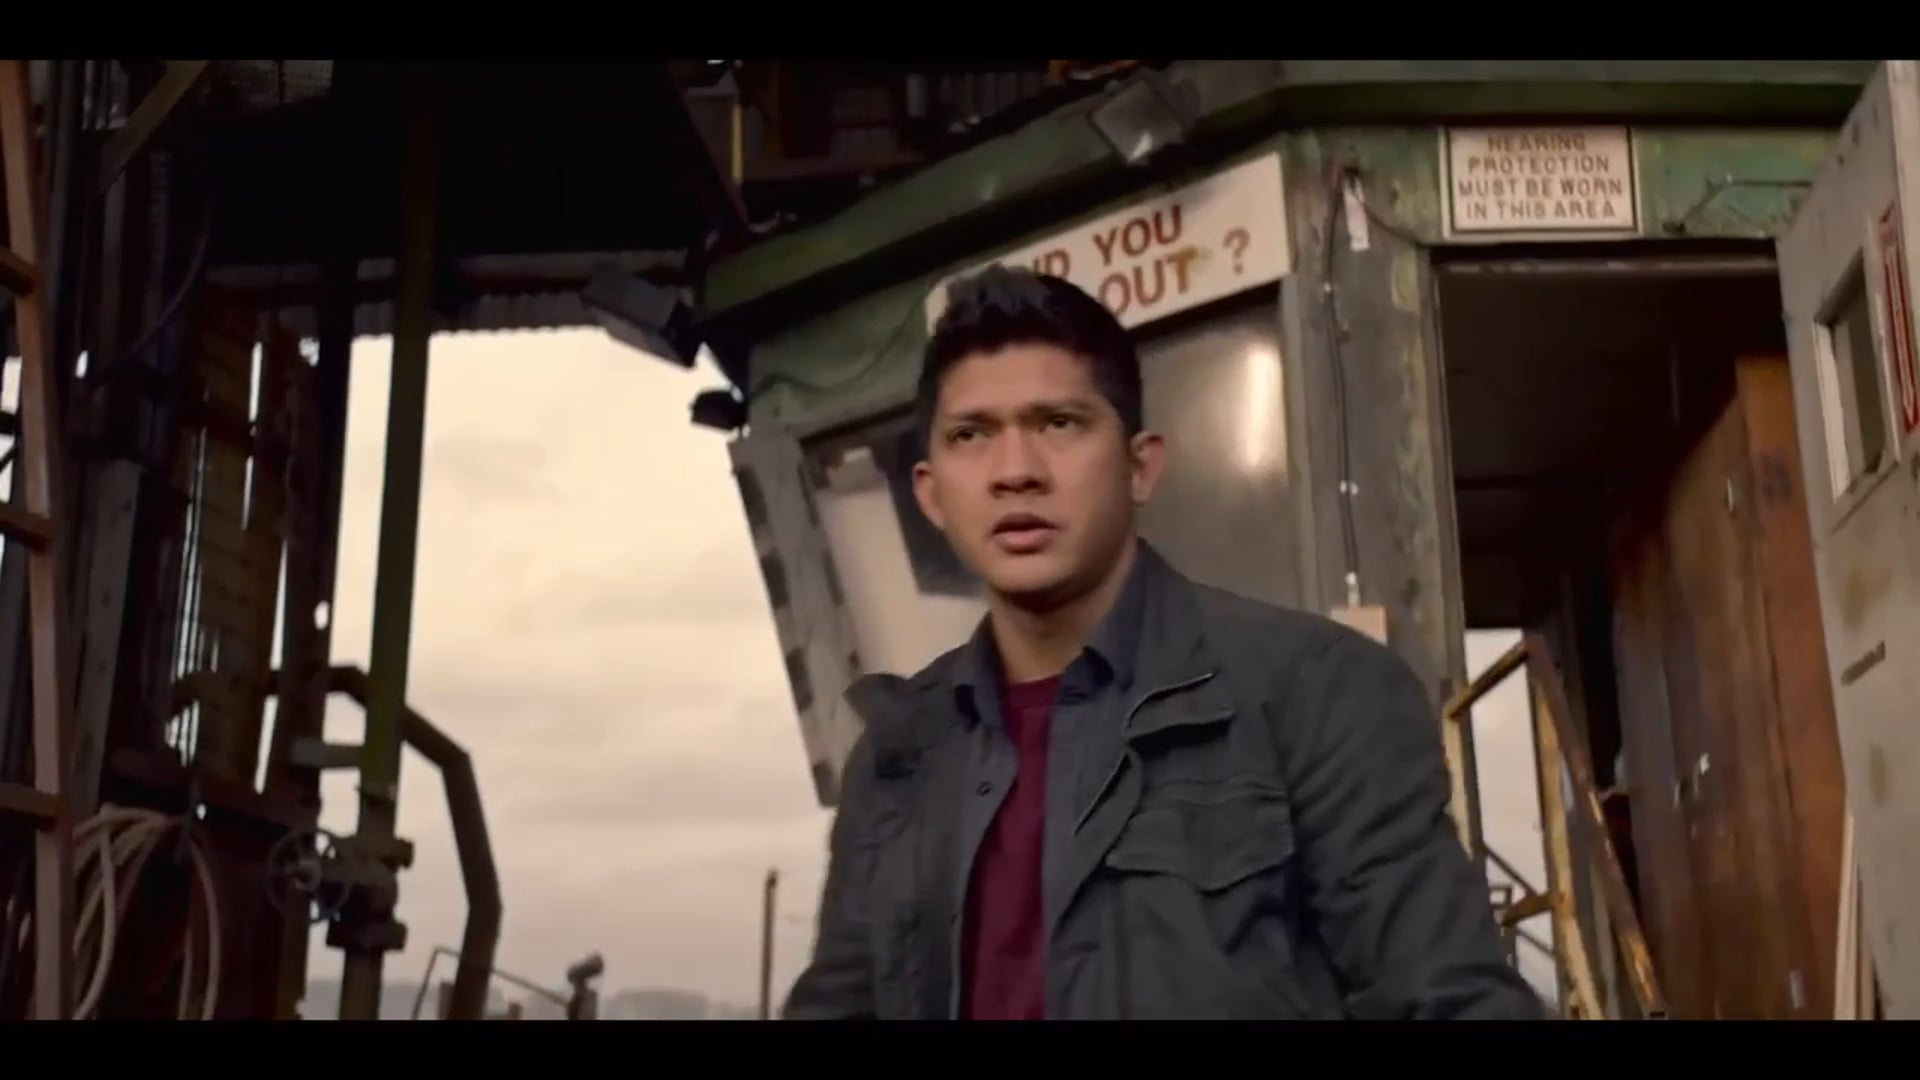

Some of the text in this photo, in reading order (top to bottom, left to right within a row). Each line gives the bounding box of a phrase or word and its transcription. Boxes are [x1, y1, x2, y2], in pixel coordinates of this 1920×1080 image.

[1487, 134, 1587, 152] HEARING
[1468, 156, 1610, 174] PROTECTION
[1458, 179, 1623, 198] MUST BE WORN
[1467, 201, 1616, 219] IN THIS AREA
[1092, 204, 1184, 267] YOU
[1223, 227, 1250, 274] ?
